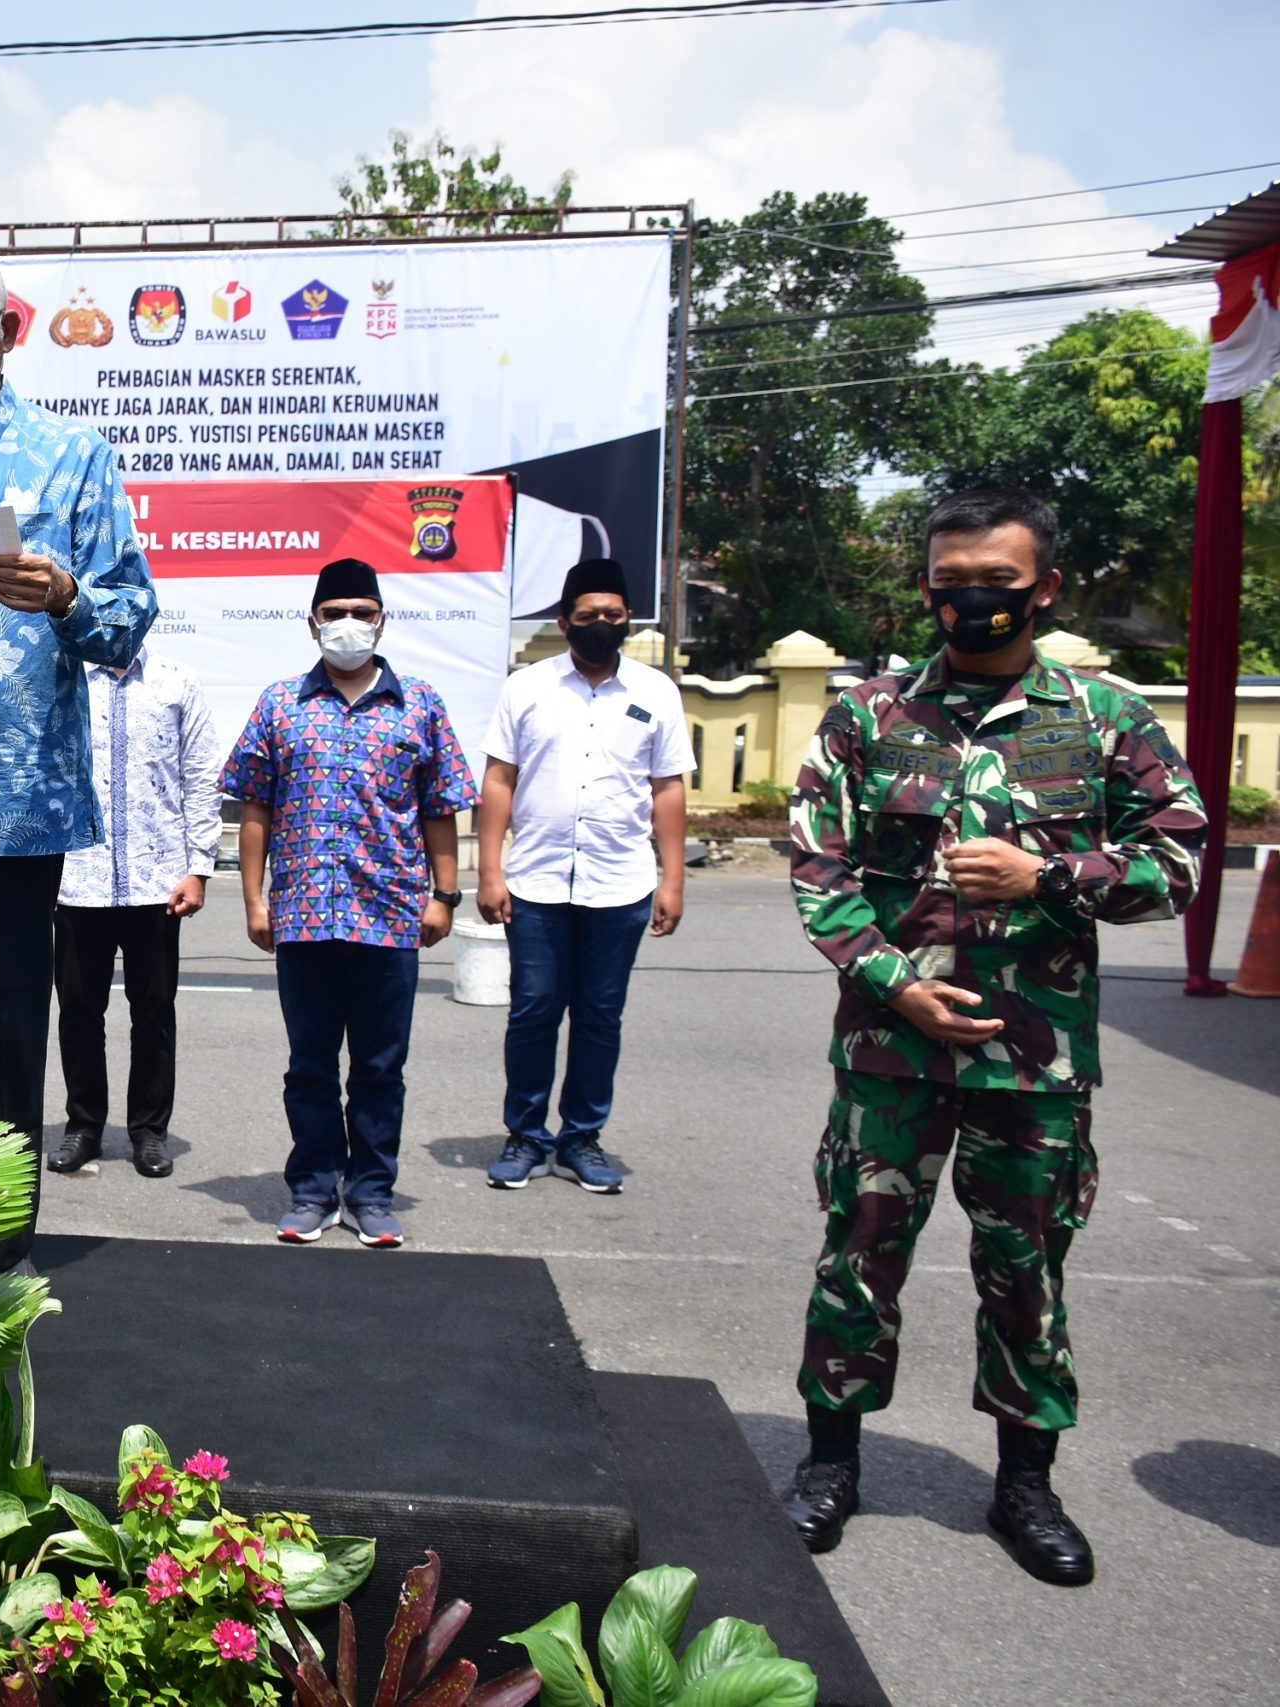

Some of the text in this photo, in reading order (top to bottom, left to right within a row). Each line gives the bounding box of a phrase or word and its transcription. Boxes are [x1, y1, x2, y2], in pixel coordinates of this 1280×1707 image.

[367, 309, 397, 319] KPC
[195, 328, 266, 341] BAWASLU
[367, 320, 396, 331] PEN
[97, 366, 362, 388] PEMBAGIAN MASKER SERENTAK,
[114, 397, 152, 416] JAGA
[157, 396, 214, 417] JARAK,
[221, 396, 252, 415] DAN
[258, 395, 326, 415] HINDARI
[332, 393, 439, 413] KERUMUNAN
[145, 426, 183, 444] OPS.
[189, 424, 252, 443] YUSTISI
[258, 422, 368, 443] PENGGUNAAN
[375, 421, 445, 441] MASKER
[131, 453, 174, 472] 2020
[179, 453, 221, 471] YANG
[227, 452, 280, 472] AMAN,
[286, 451, 346, 472] DAMAI,
[352, 451, 384, 470] DAN
[390, 450, 443, 469] SEHAT
[171, 530, 320, 550] KESEHATAN
[156, 610, 186, 620] ASLU
[222, 609, 284, 620] PASANGAN
[287, 609, 311, 620] CAL
[399, 610, 433, 621] WAKIL
[436, 610, 476, 621] BUPATI
[150, 624, 196, 634] SLEMAN
[1011, 756, 1057, 776] TNI
